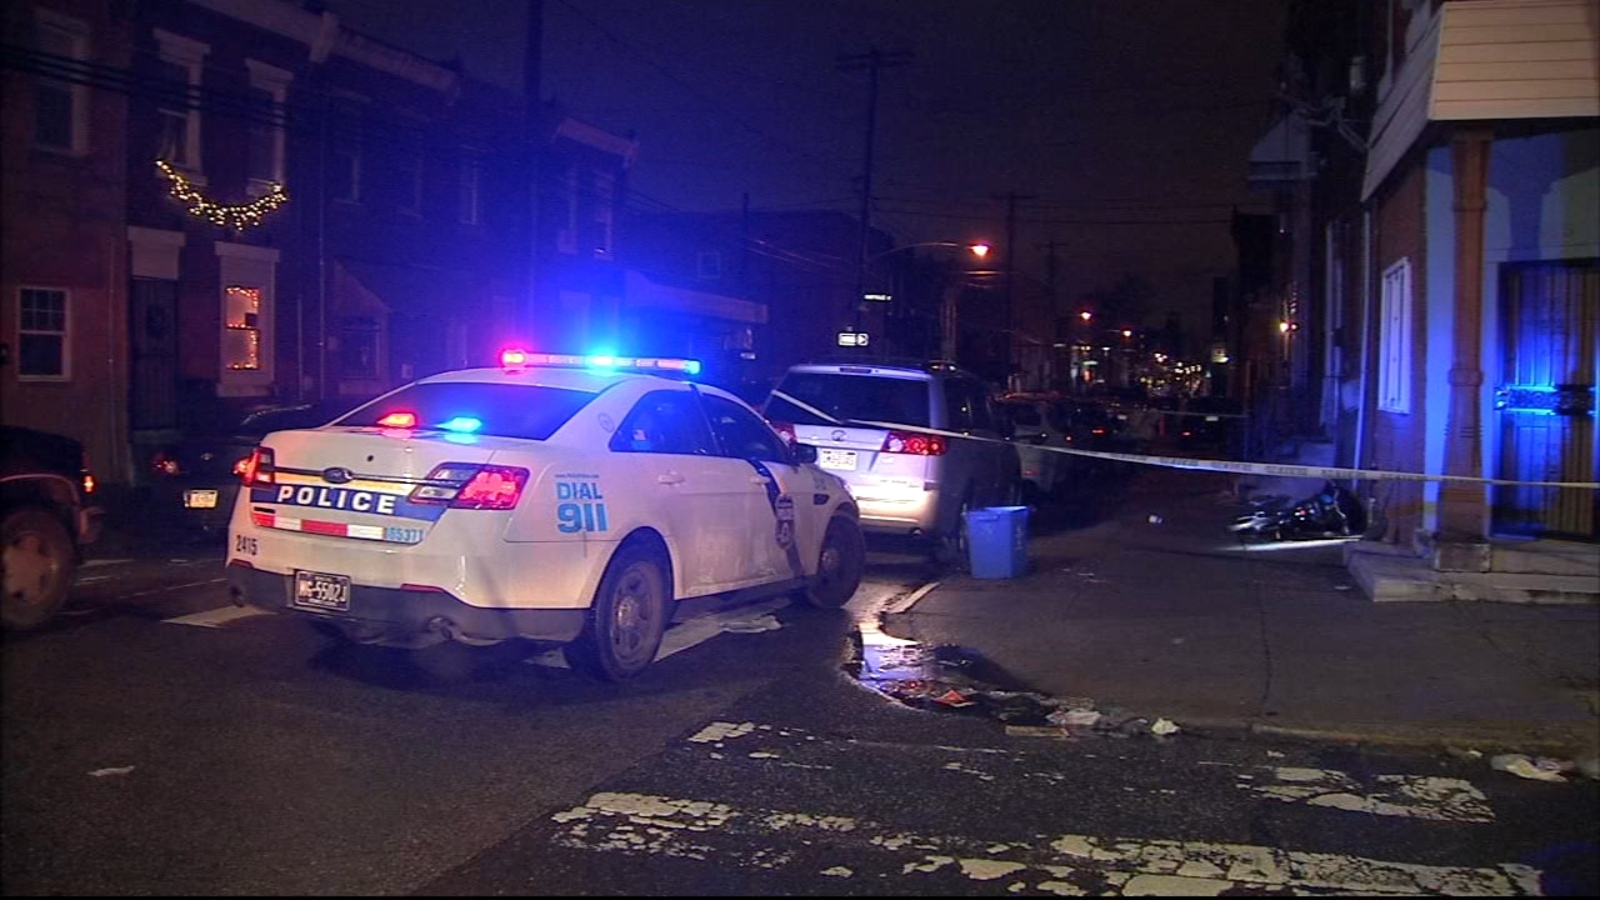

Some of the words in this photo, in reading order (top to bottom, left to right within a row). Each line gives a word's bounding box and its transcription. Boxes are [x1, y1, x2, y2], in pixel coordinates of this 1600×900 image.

[277, 486, 395, 514] POLICE
[556, 482, 603, 499] DIAL
[557, 503, 608, 533] 911
[236, 534, 257, 556] 2415
